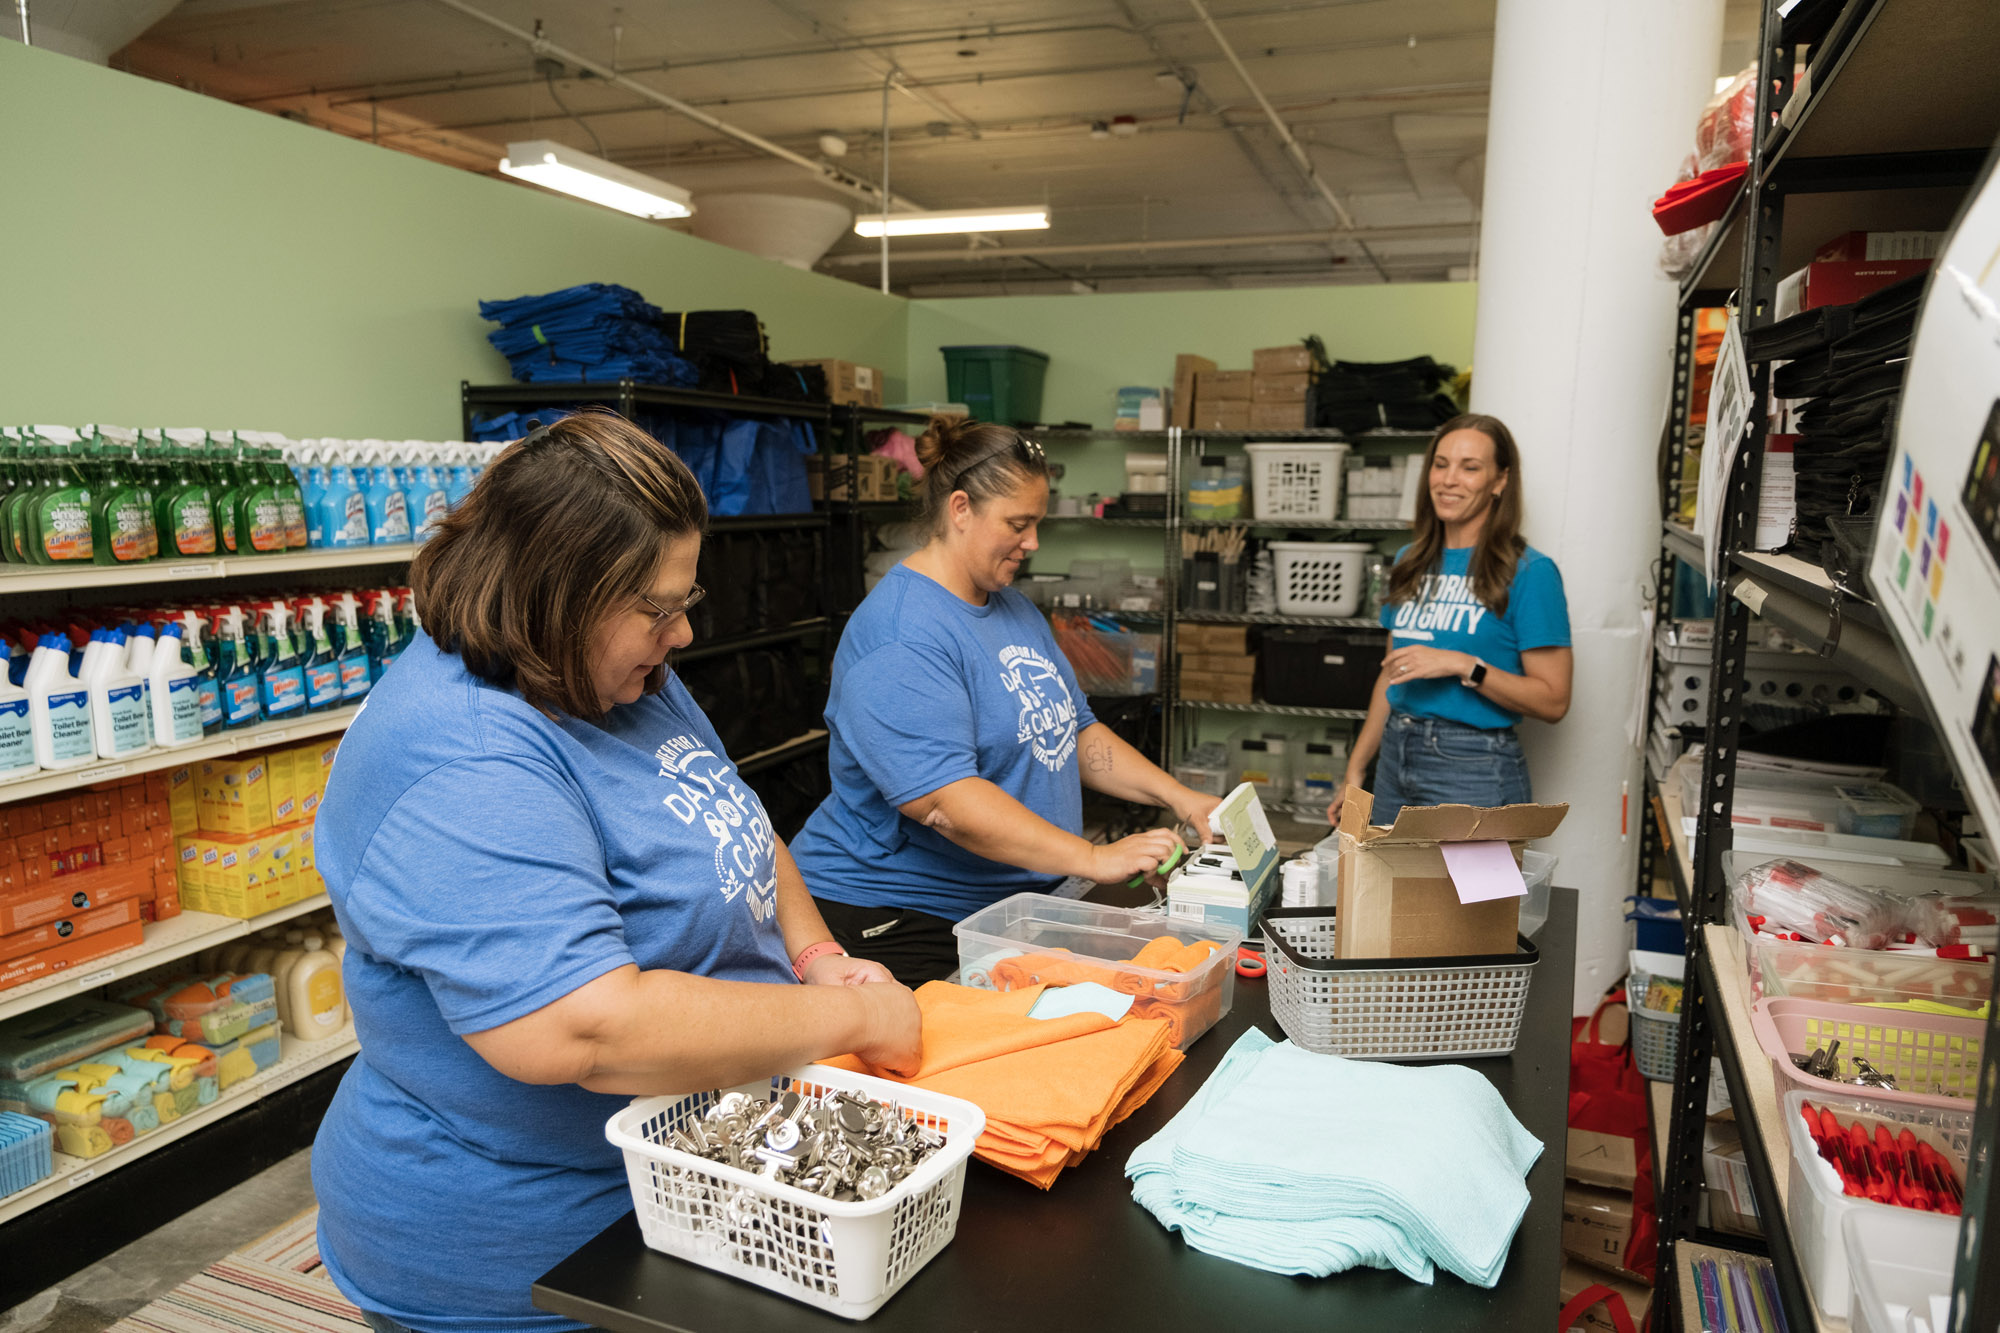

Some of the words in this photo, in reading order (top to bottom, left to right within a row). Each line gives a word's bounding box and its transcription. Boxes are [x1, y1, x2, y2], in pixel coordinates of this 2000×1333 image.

[1395, 600, 1486, 635] DIGNITY
[173, 704, 190, 712] Toilet
[113, 715, 132, 723] Toilet
[133, 712, 144, 720] Bow
[1031, 699, 1077, 736] CARING
[53, 721, 76, 730] Toilet
[114, 722, 139, 732] Cleaner
[53, 730, 82, 739] Cleaner
[667, 735, 695, 753] FOR
[663, 771, 716, 825] DAY
[0, 968, 25, 982] plastic
[26, 961, 46, 973] wrap
